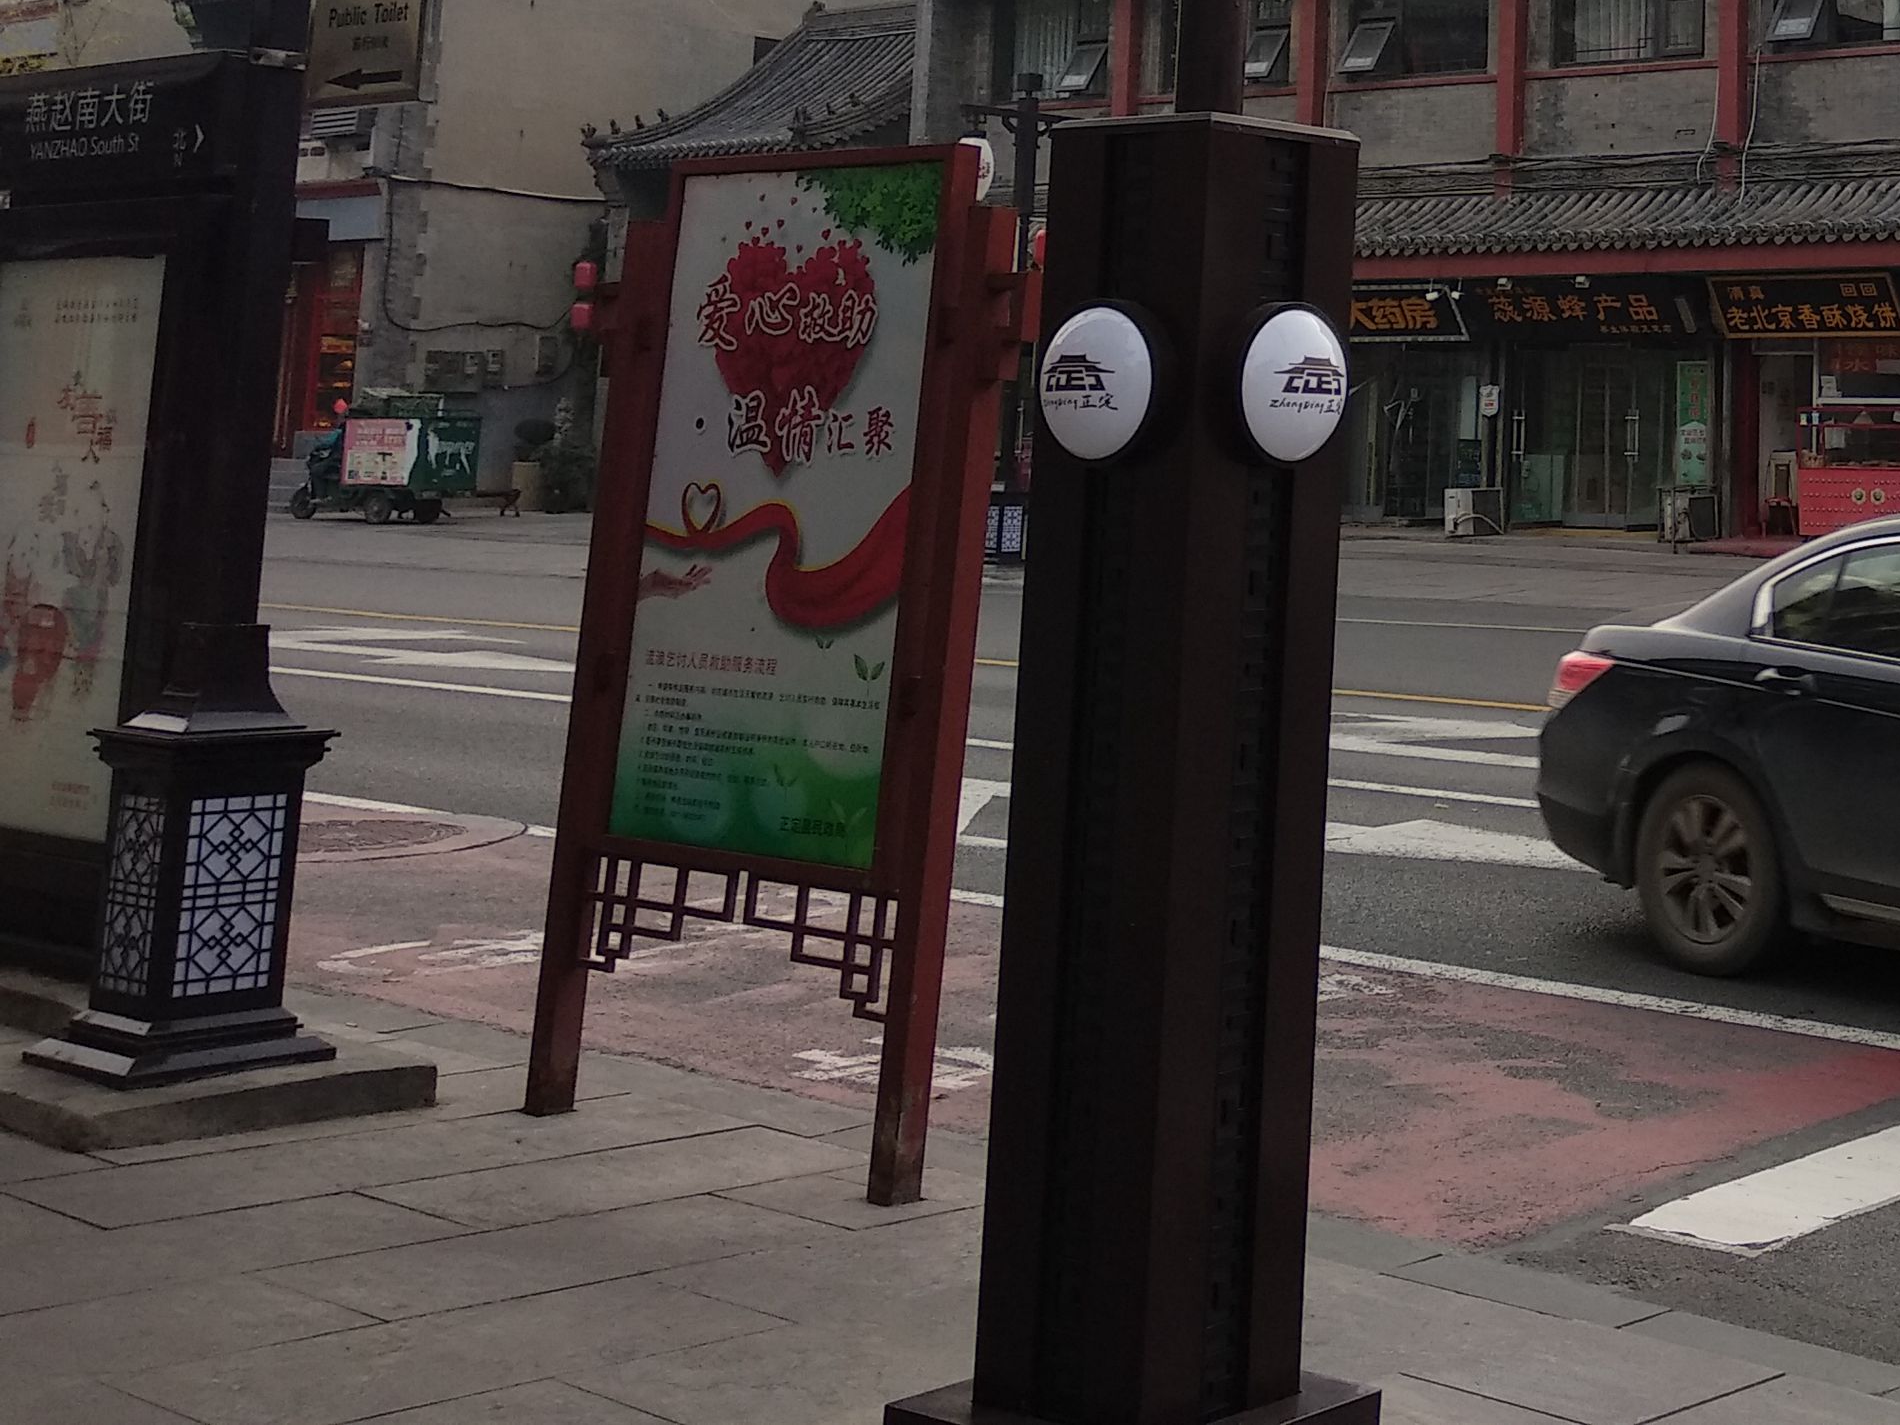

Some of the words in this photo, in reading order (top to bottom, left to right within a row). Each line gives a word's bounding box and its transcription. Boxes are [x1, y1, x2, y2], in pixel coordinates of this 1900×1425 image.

[328, 6, 367, 29] Public
[374, 1, 409, 24] Toilet
[26, 80, 154, 134] 燕赵南大街
[30, 137, 88, 161] YANZHAO
[90, 134, 126, 157] South
[128, 132, 140, 153] St
[697, 274, 878, 350] 爱心救助
[1726, 302, 1897, 331] 老北京香酥烧饼
[727, 385, 896, 466] 温情汇聚
